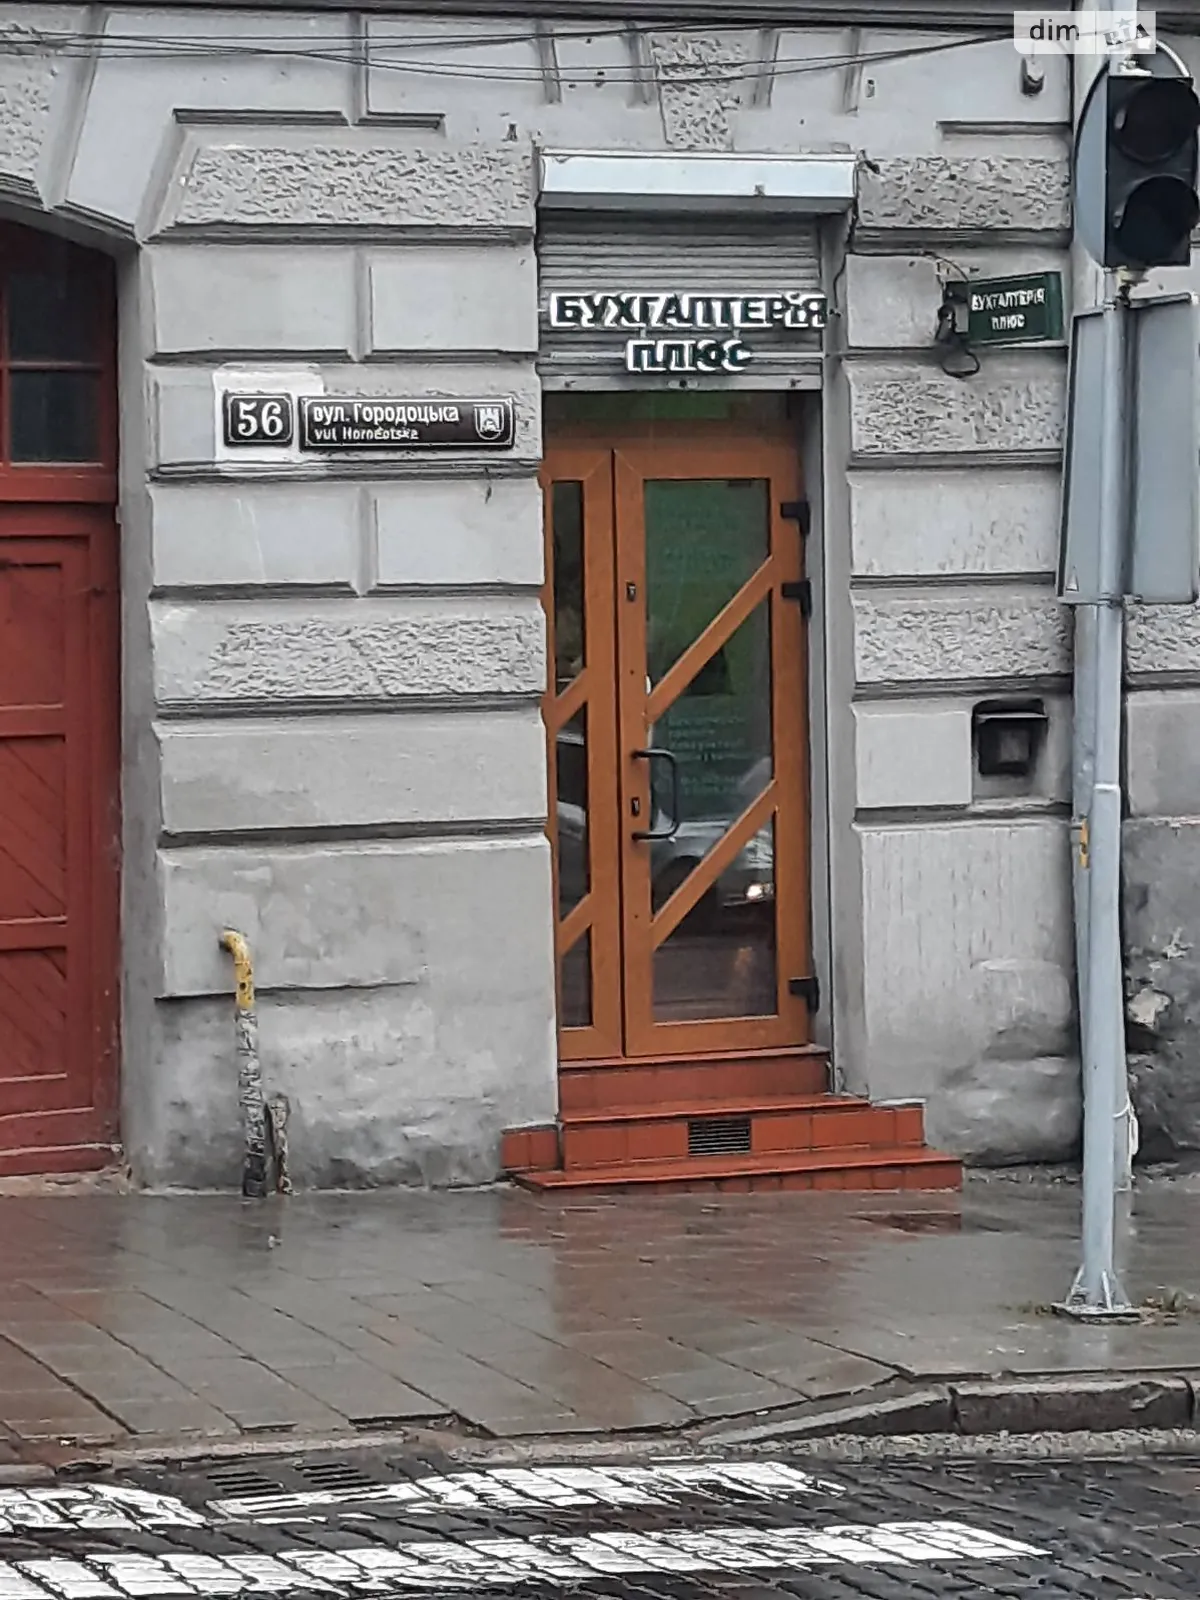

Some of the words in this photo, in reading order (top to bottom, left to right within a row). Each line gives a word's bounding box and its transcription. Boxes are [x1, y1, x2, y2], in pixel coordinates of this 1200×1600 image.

[991, 314, 1025, 330] ПЛЮС
[626, 339, 751, 371] ПЛЮС
[238, 401, 283, 437] 56
[313, 405, 350, 426] вул.
[353, 403, 460, 427] Городоцька
